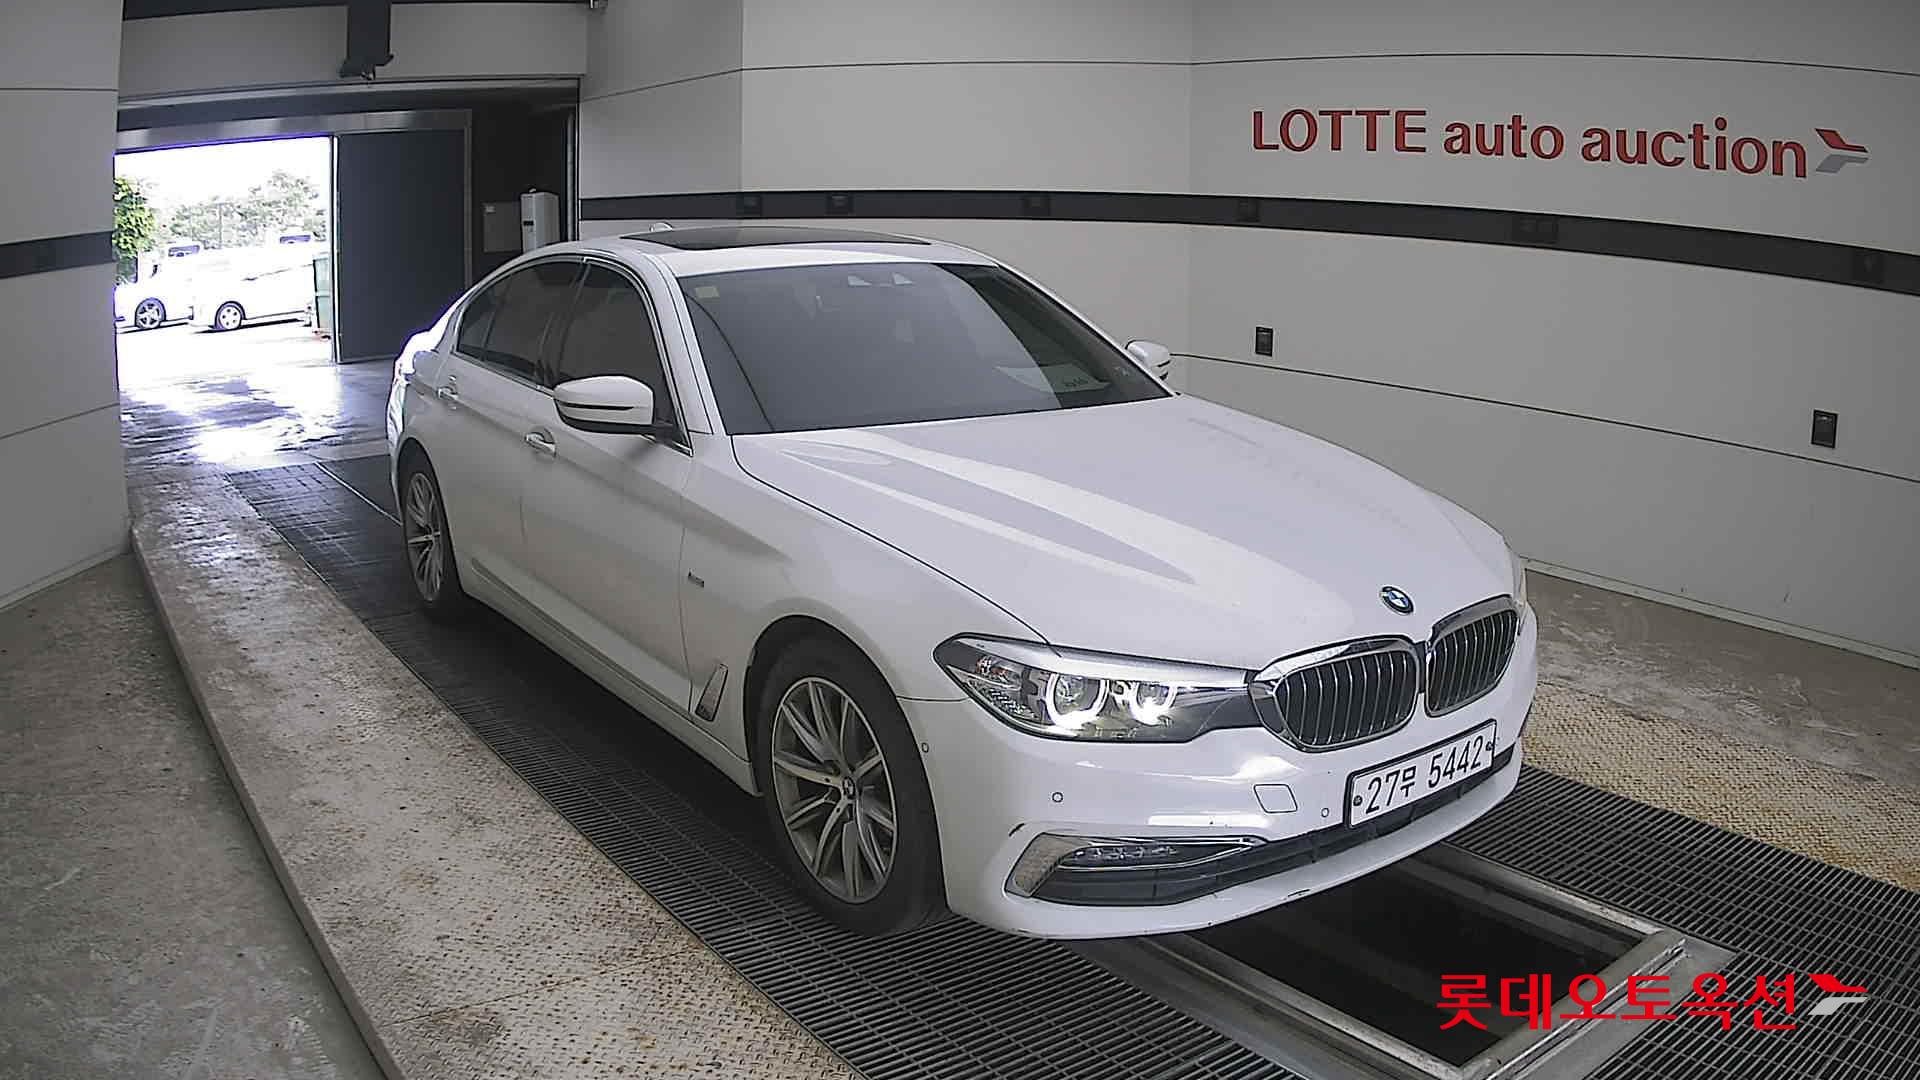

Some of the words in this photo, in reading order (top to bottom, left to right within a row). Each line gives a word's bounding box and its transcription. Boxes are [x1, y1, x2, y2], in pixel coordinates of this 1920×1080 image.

[1252, 109, 1428, 153] LOTTE
[1443, 114, 1565, 160] auto
[1580, 117, 1808, 179] auction
[1365, 766, 1417, 814] 27무
[1428, 735, 1484, 789] 5442
